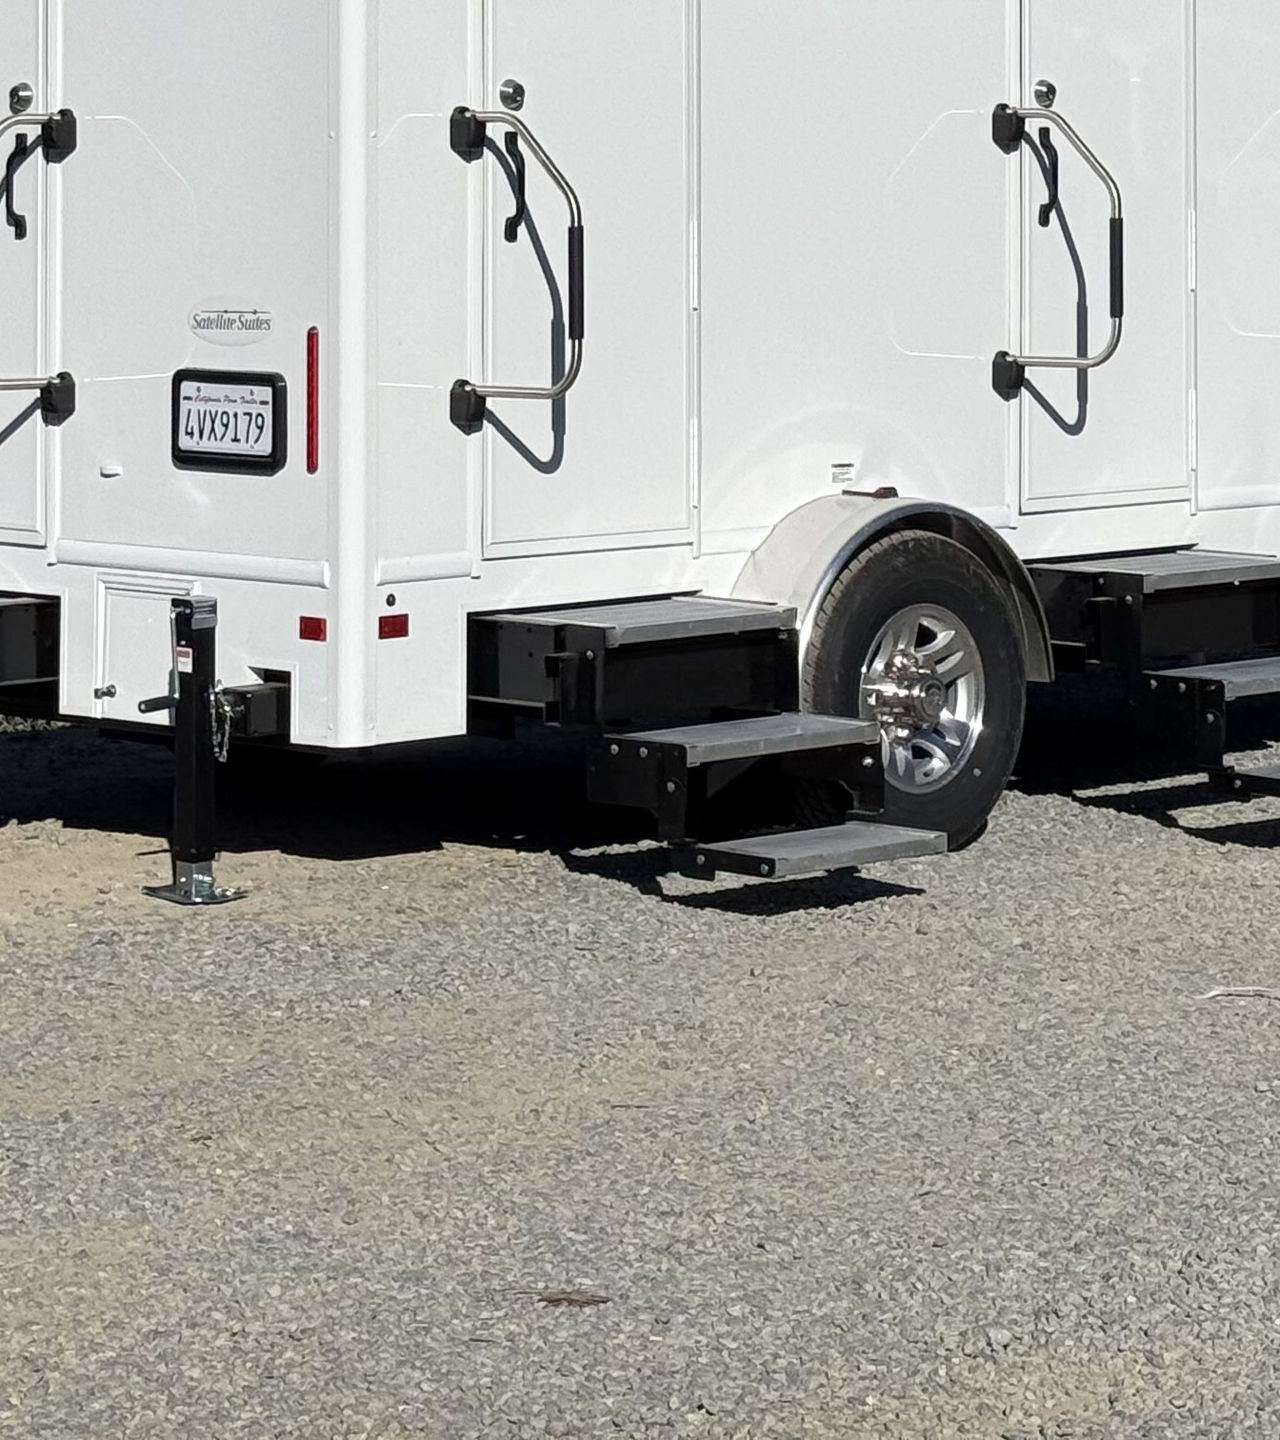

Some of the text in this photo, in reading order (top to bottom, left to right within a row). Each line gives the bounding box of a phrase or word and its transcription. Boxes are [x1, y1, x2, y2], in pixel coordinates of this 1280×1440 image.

[191, 313, 272, 331] Satellite Suites
[184, 408, 266, 445] 4VX9179
